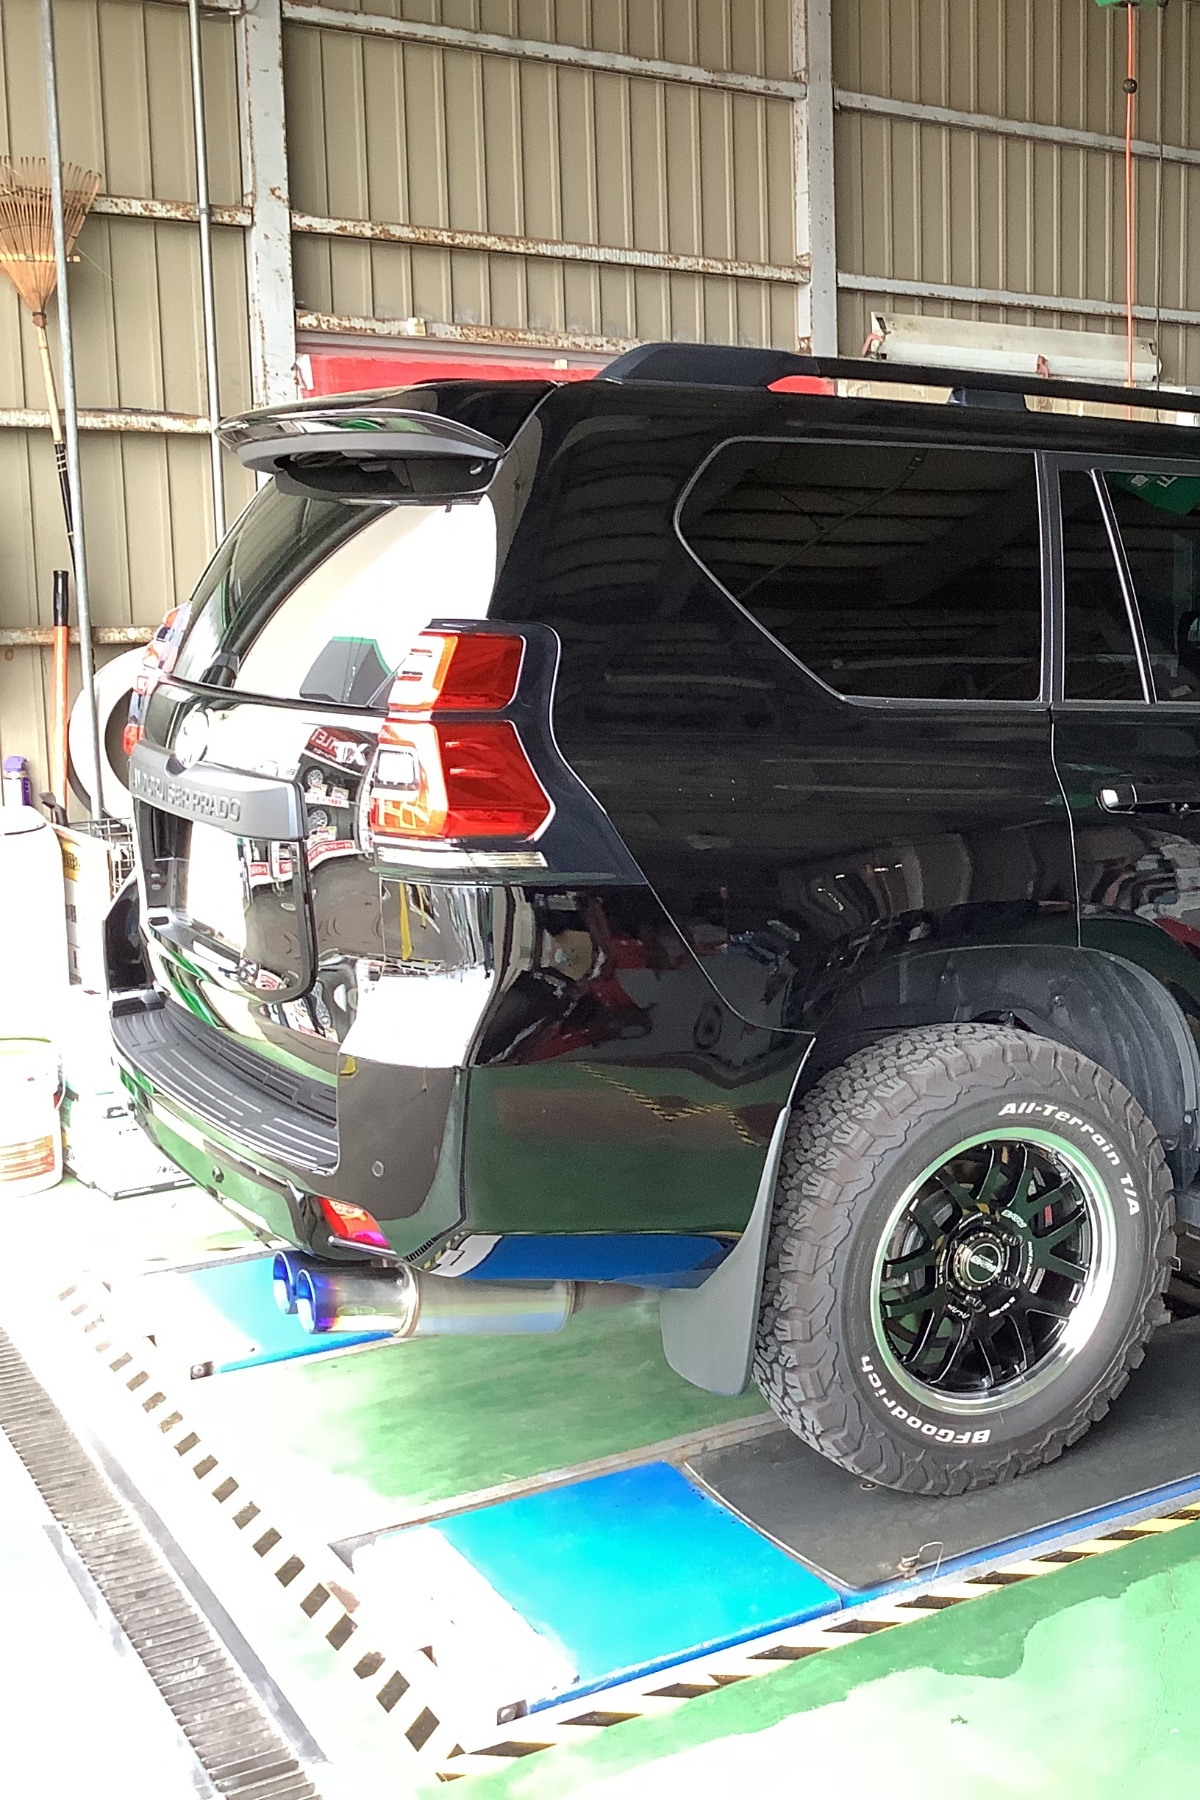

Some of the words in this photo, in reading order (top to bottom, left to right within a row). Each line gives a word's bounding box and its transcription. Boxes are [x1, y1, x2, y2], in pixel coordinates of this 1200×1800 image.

[192, 790, 242, 822] PRADO
[998, 1102, 1121, 1166] All-Terrain
[1120, 1172, 1140, 1216] T/A
[861, 1355, 991, 1444] BFGoodrich
